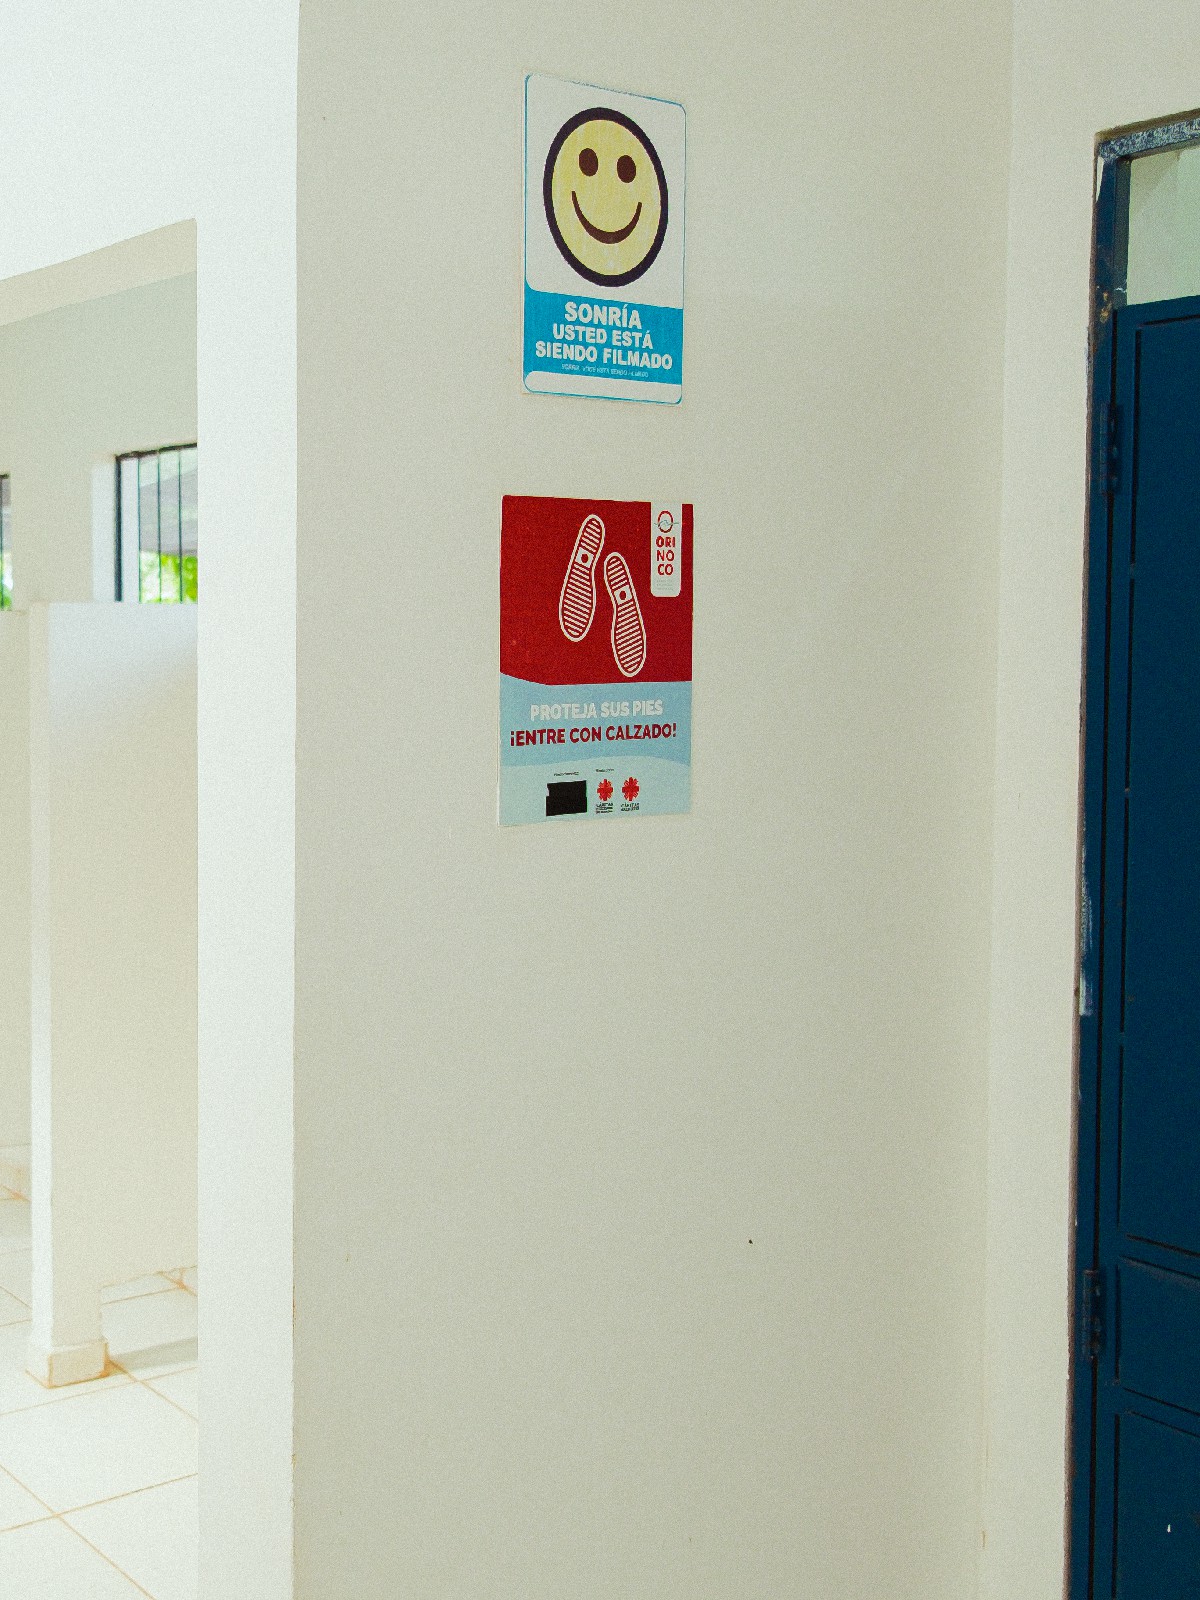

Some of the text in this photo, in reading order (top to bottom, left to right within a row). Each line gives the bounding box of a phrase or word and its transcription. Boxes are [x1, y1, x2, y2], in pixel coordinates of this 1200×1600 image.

[564, 301, 642, 330] SONRÍA
[552, 323, 653, 350] USTED ESTÁ
[535, 340, 673, 370] SIENDO FILMADO
[655, 535, 676, 548] ORI
[656, 549, 675, 562] NO
[657, 563, 674, 576] CO
[530, 699, 664, 722] PROTEJA SUS PIES
[510, 722, 677, 747] ¡ENTRE CON CALZADO!
